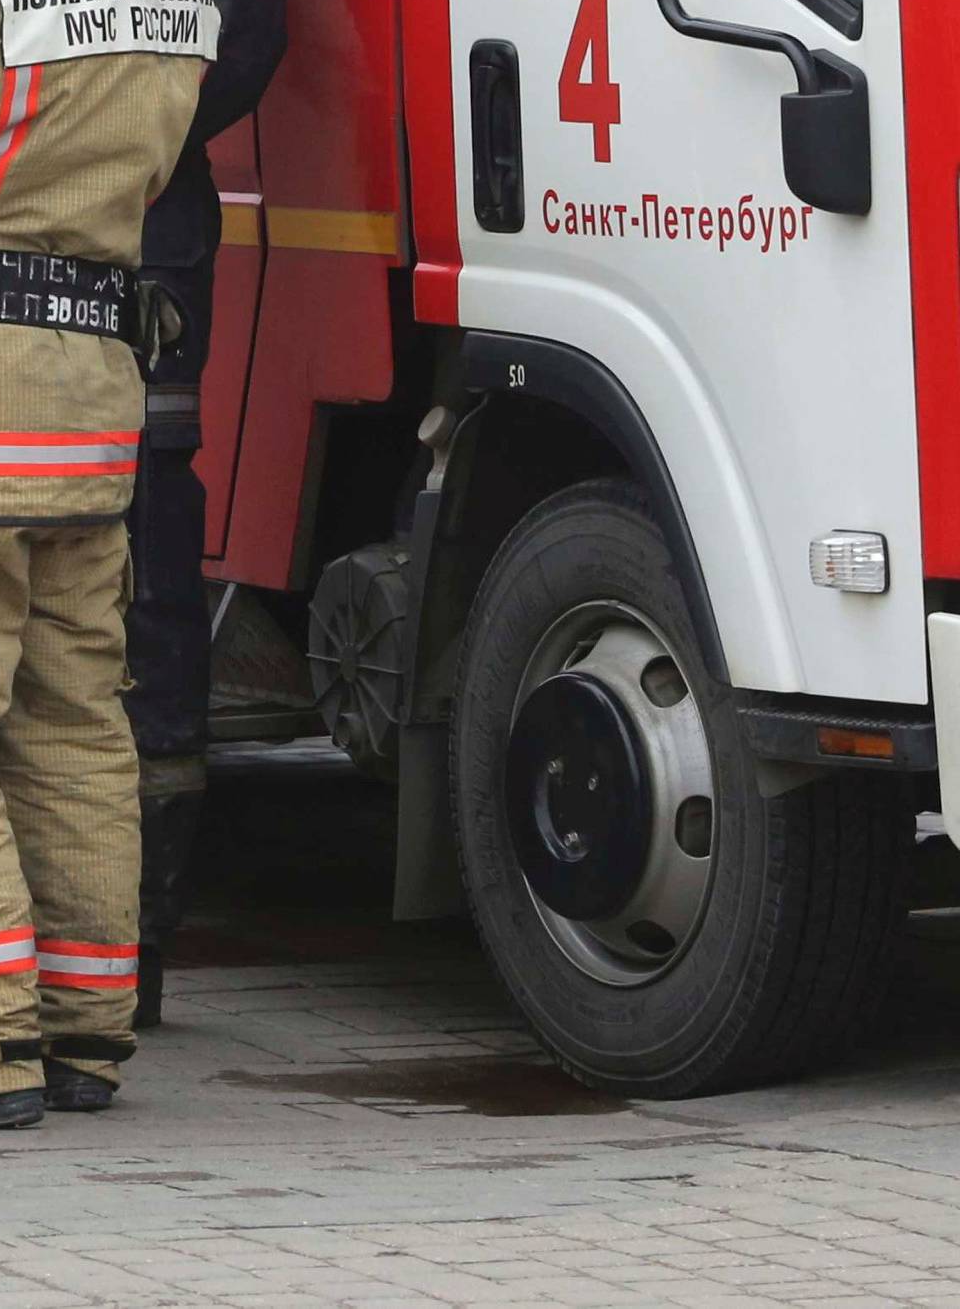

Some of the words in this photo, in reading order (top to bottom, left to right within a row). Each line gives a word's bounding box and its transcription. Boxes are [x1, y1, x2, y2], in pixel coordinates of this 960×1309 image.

[64, 6, 117, 46] МЧС
[130, 6, 198, 44] РОССИИ
[542, 189, 814, 253] Санкт-Петербург
